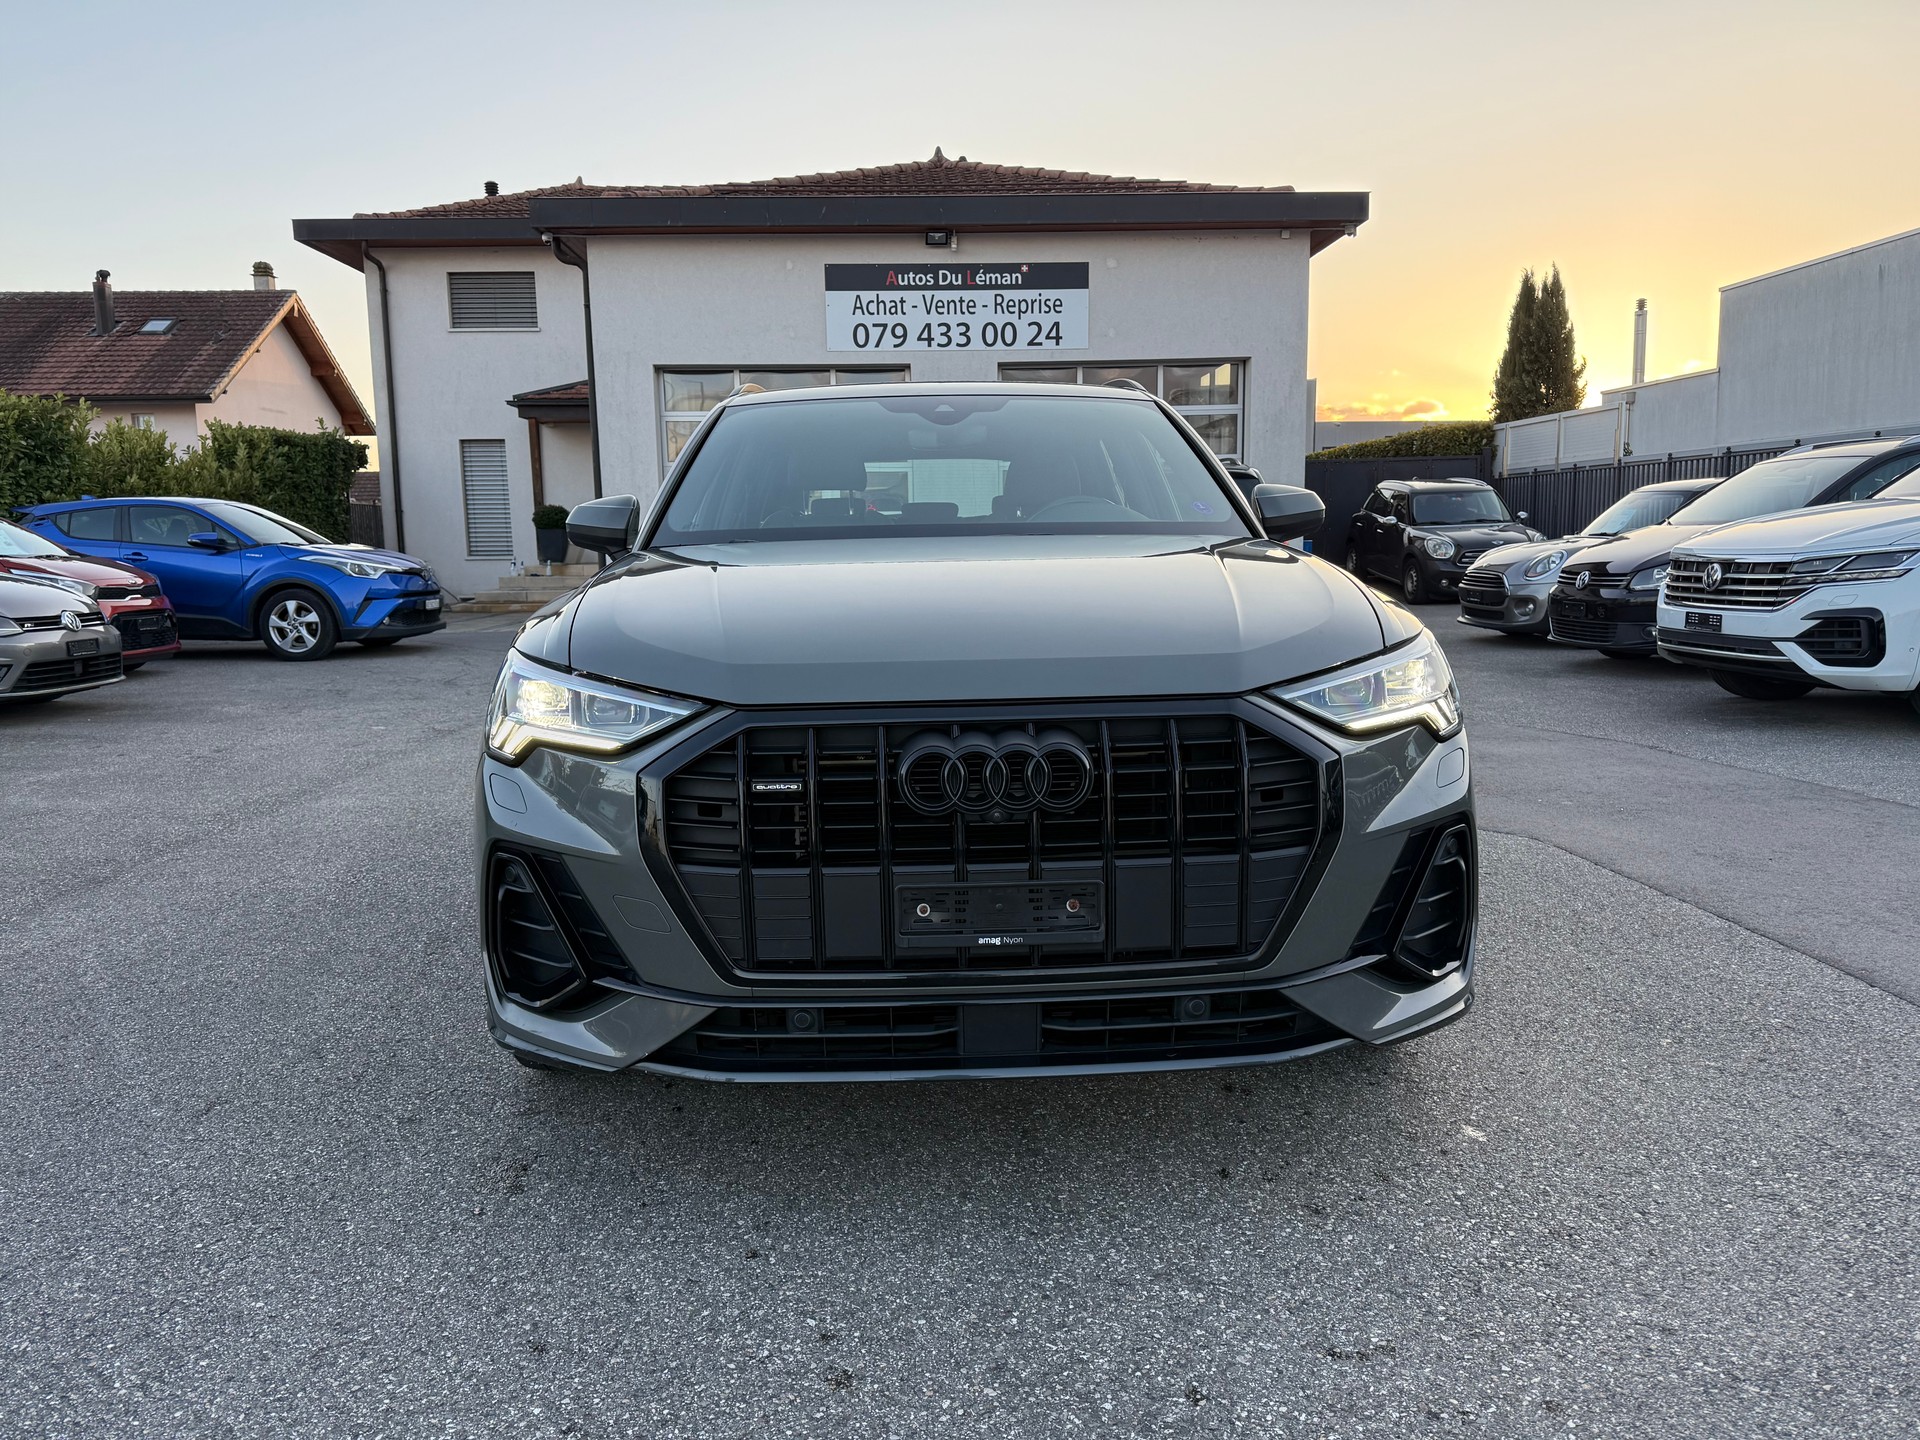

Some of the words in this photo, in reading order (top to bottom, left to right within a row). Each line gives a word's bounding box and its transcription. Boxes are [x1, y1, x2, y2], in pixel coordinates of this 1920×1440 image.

[886, 270, 934, 286] Autos
[938, 269, 962, 286] Du
[967, 268, 1022, 286] Léman
[852, 294, 907, 316] Achat
[922, 294, 977, 316] Vente
[994, 292, 1063, 320] Reprise
[852, 322, 908, 348] 079
[917, 322, 972, 348] 433
[981, 322, 1018, 348] 00
[1026, 321, 1063, 347] 24
[978, 937, 1001, 945] amag
[1003, 936, 1024, 944] Nyon
